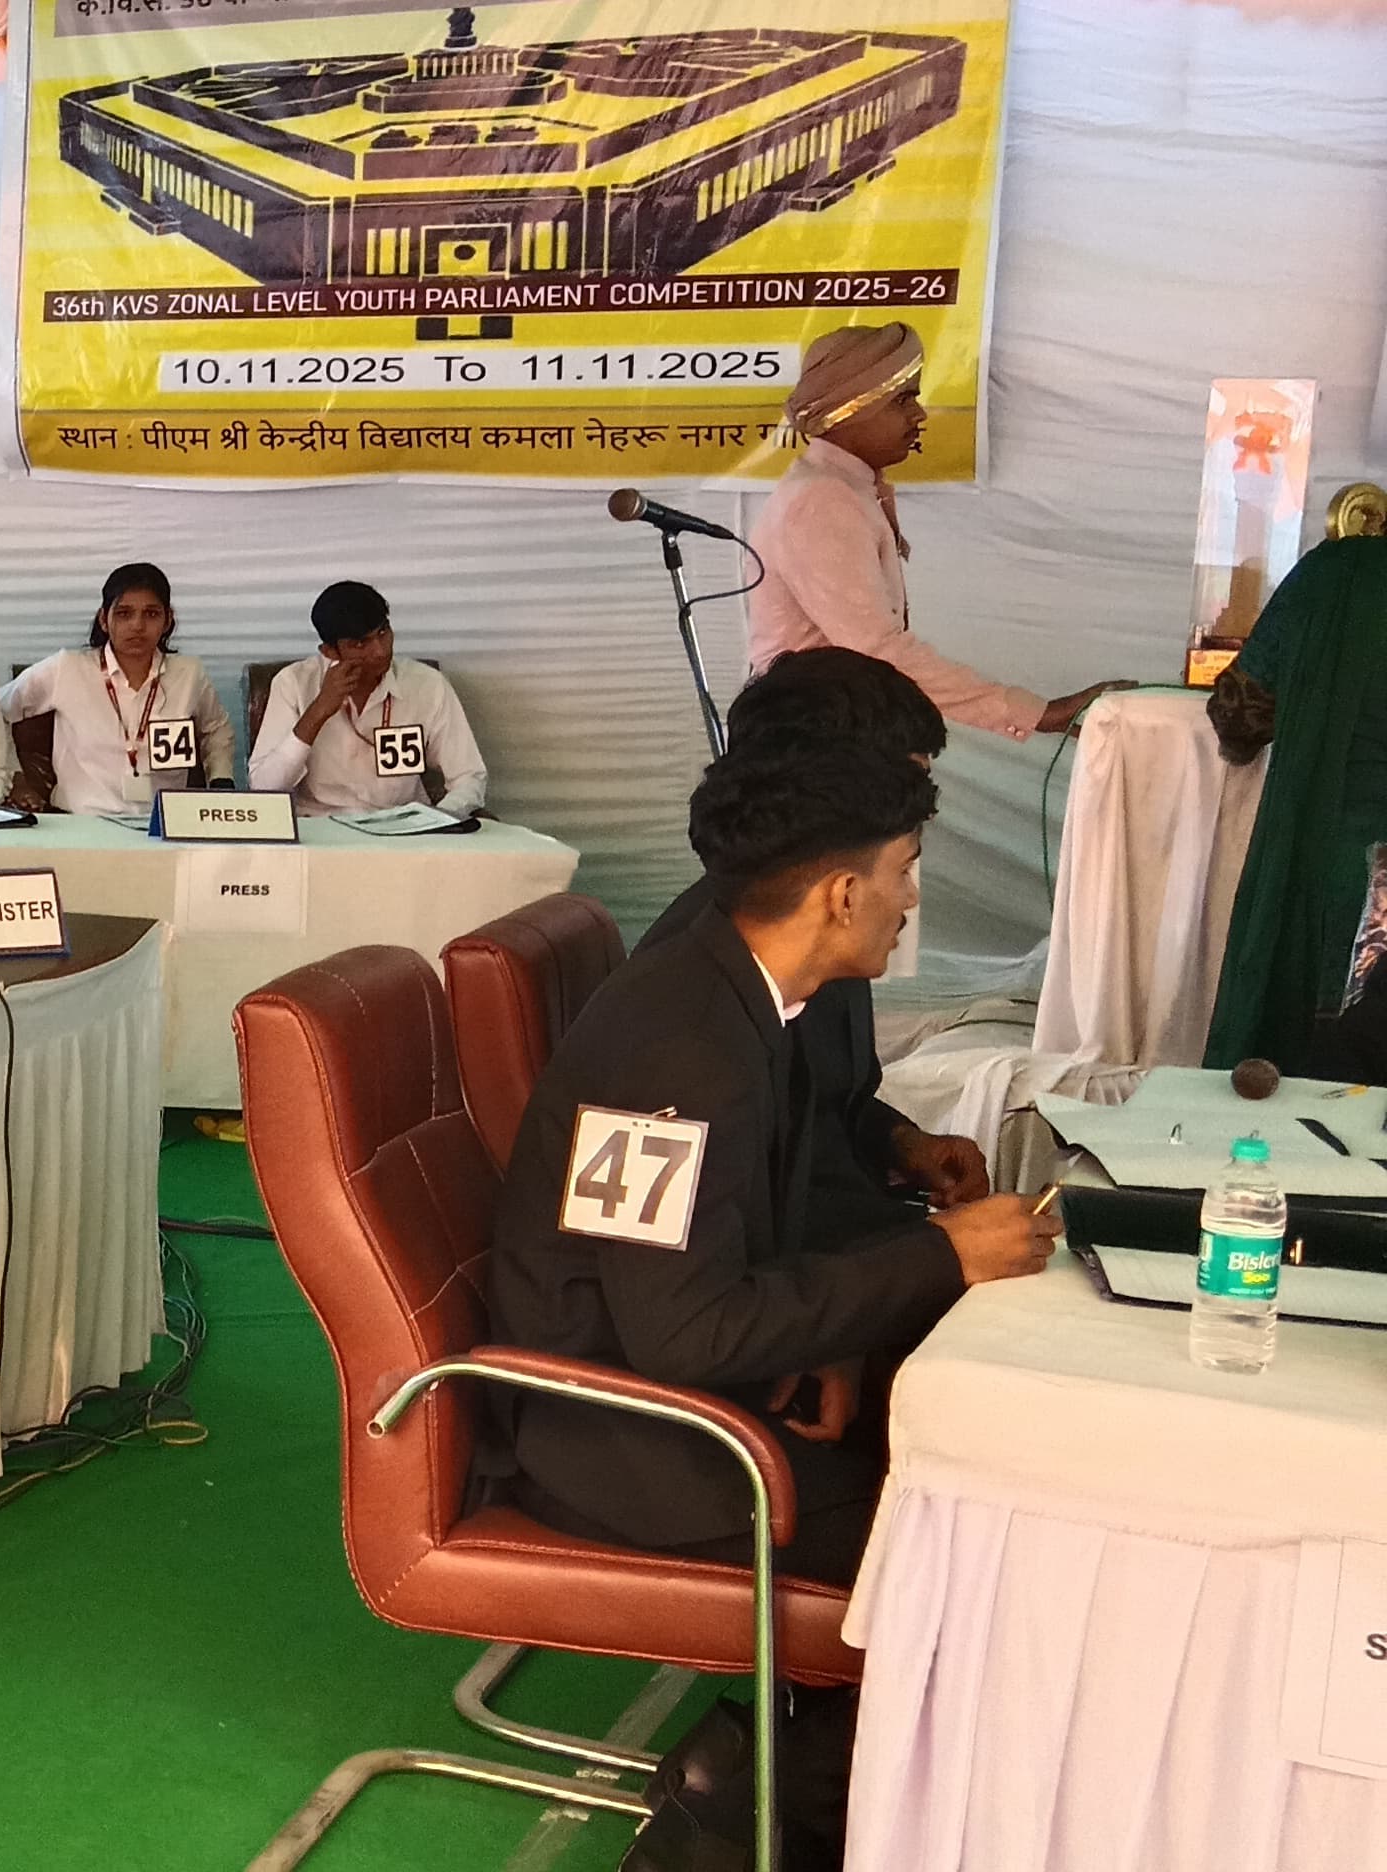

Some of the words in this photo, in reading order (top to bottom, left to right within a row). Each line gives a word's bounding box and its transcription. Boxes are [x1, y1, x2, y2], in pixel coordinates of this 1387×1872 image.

[52, 296, 104, 316] 36th
[112, 294, 159, 315] KVS
[166, 293, 244, 315] ZONAL
[253, 290, 327, 313] LEVEL
[335, 288, 415, 312] YOUTH
[425, 284, 601, 311] PARLIAMENT
[610, 278, 804, 306] COMPETITION
[814, 276, 946, 301] 2025-26
[174, 356, 405, 384] 10.11.2025
[434, 355, 487, 382] To
[521, 350, 781, 381] 11.11.2025
[57, 427, 118, 449] स्थान
[141, 420, 211, 453] पीएम
[220, 420, 250, 450] श्री
[257, 420, 350, 451] केन्द्रीय
[359, 421, 472, 449] विद्यालय
[480, 425, 575, 449] कमला
[584, 418, 670, 451] नेहरू
[677, 424, 748, 449] नगर
[153, 726, 194, 764] 54
[379, 733, 421, 770] 55
[199, 808, 258, 823] PRESS
[221, 885, 270, 896] PRESS
[573, 1129, 693, 1226] 47
